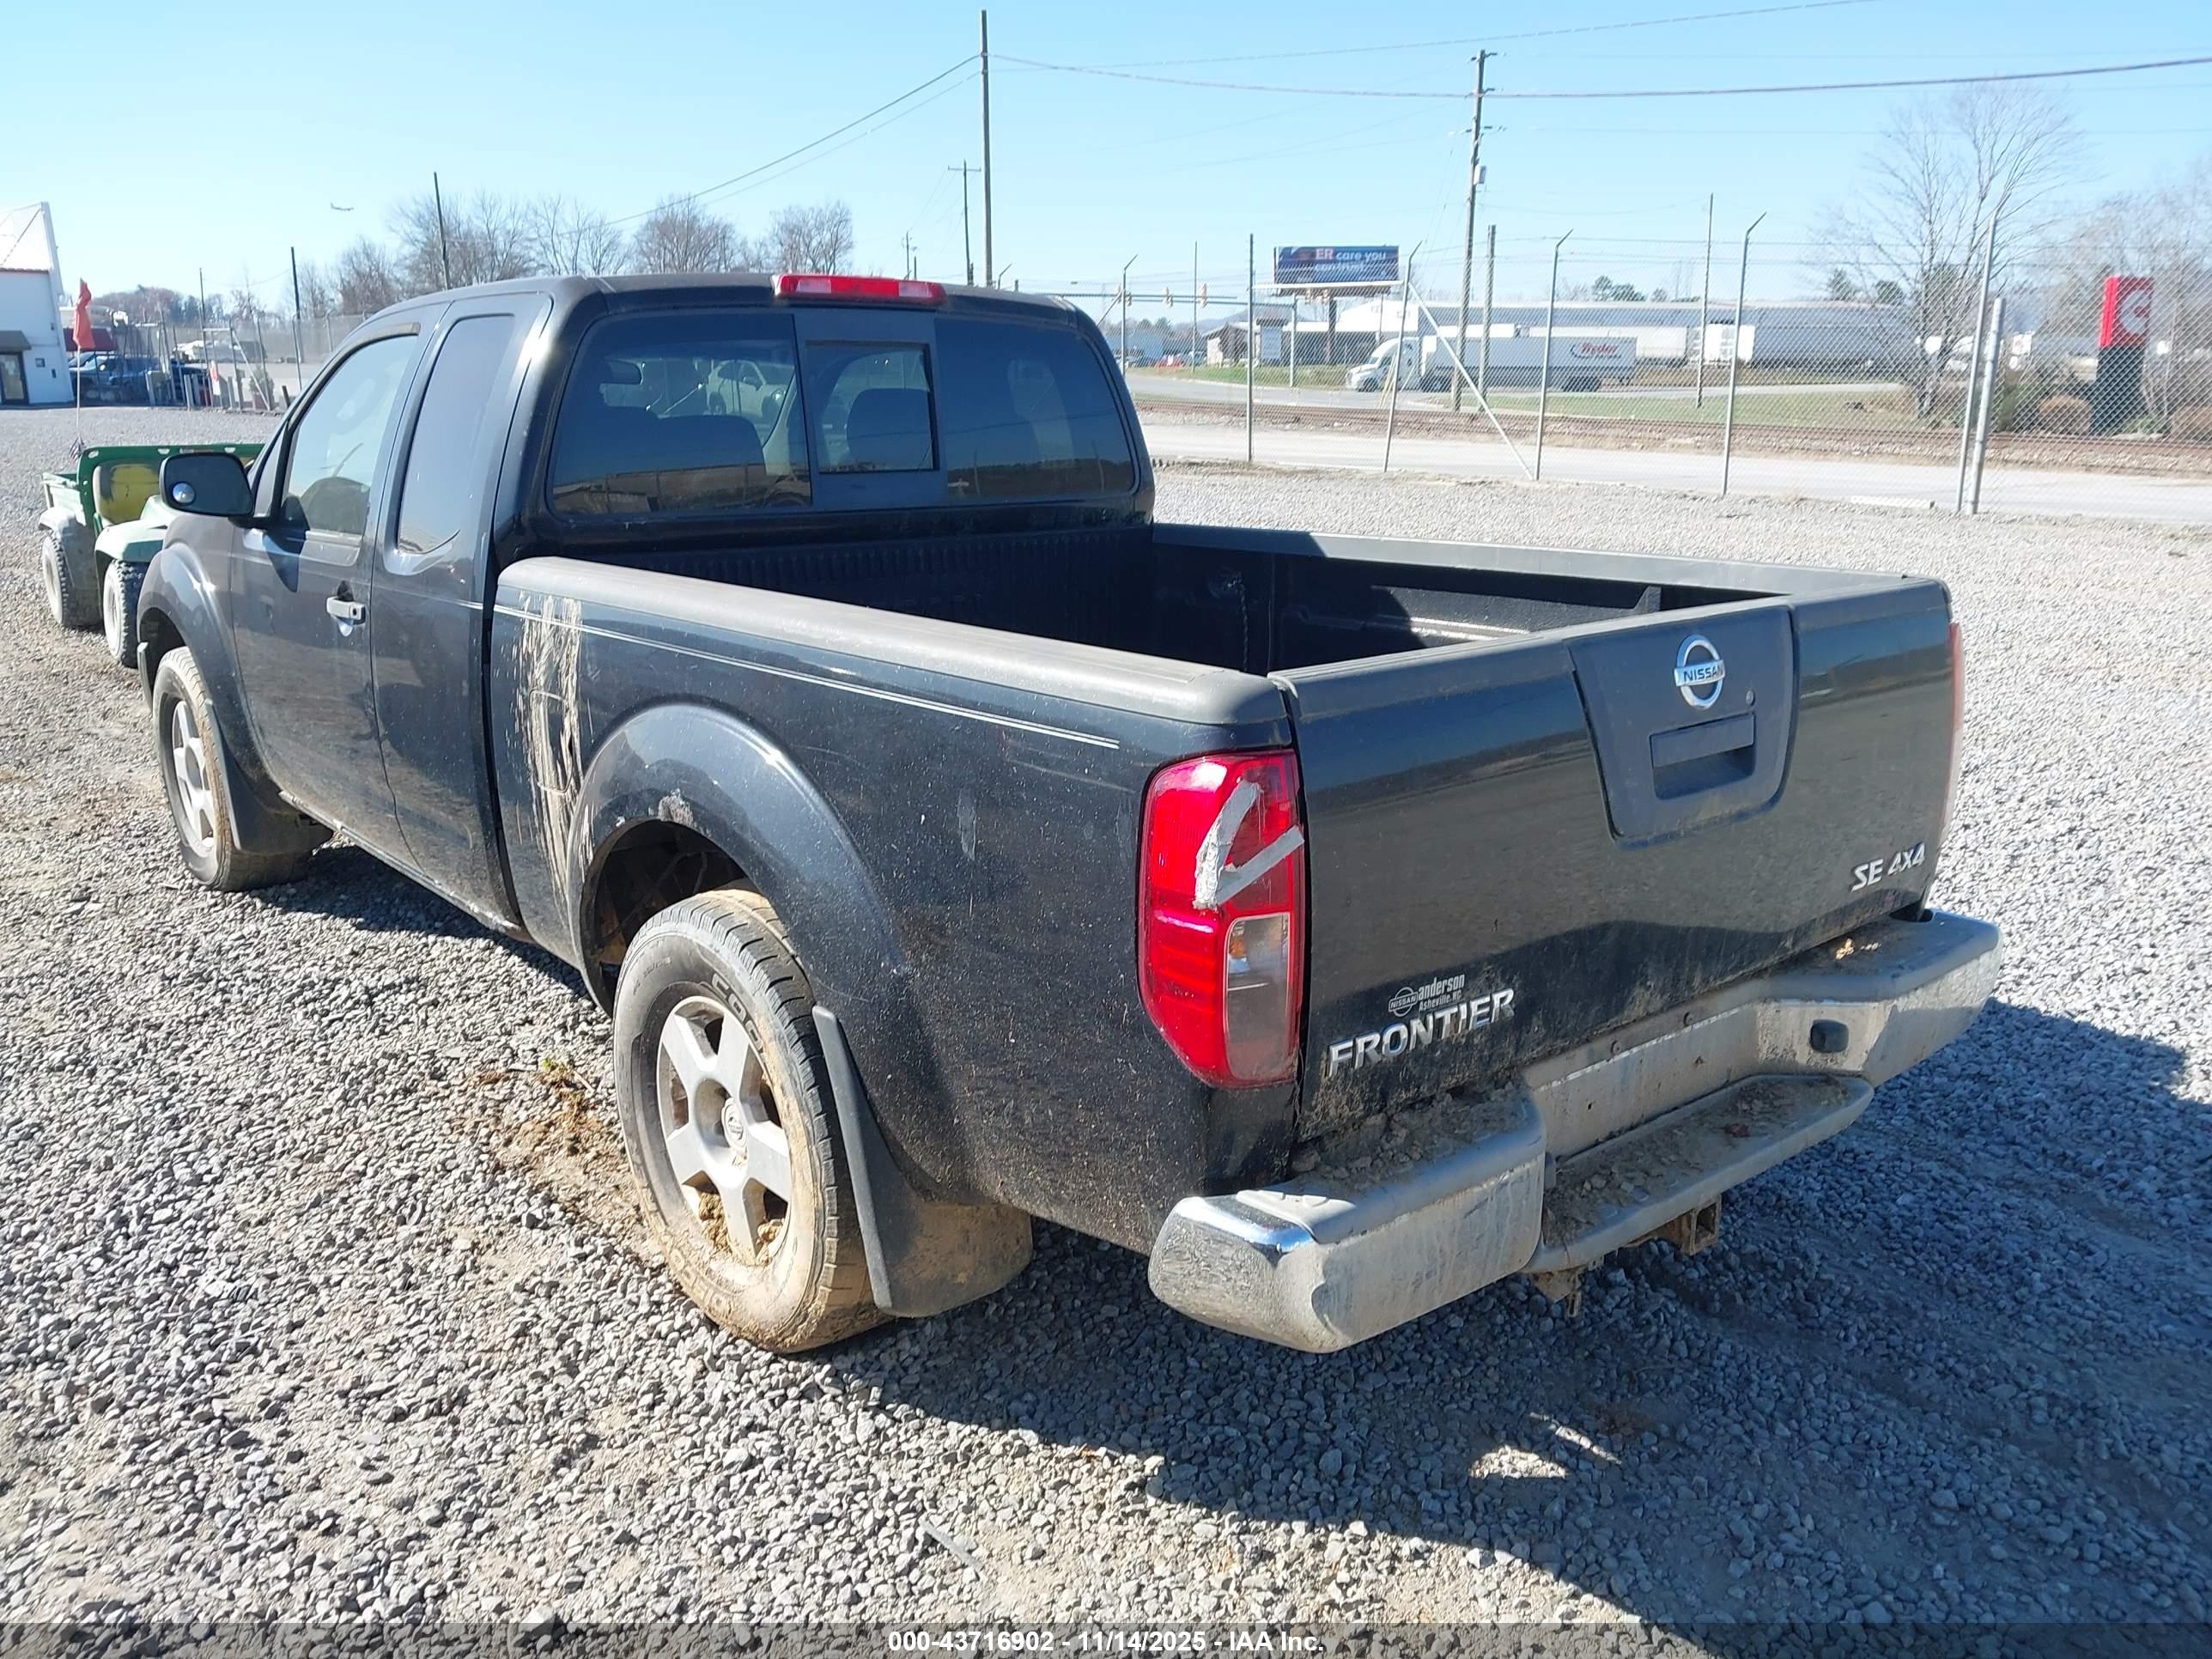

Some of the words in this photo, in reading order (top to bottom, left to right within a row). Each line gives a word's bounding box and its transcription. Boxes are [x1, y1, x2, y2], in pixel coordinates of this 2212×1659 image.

[1316, 248, 1334, 260] ER
[1336, 252, 1362, 261] care
[1365, 252, 1387, 263] you
[1683, 665, 1723, 683] NISSAN
[1850, 859, 1884, 892] SE
[1418, 974, 1465, 1001] anderson
[1452, 990, 1462, 1003] NC
[1390, 994, 1417, 1009] NISSAN
[1328, 988, 1515, 1079] FRONTIER
